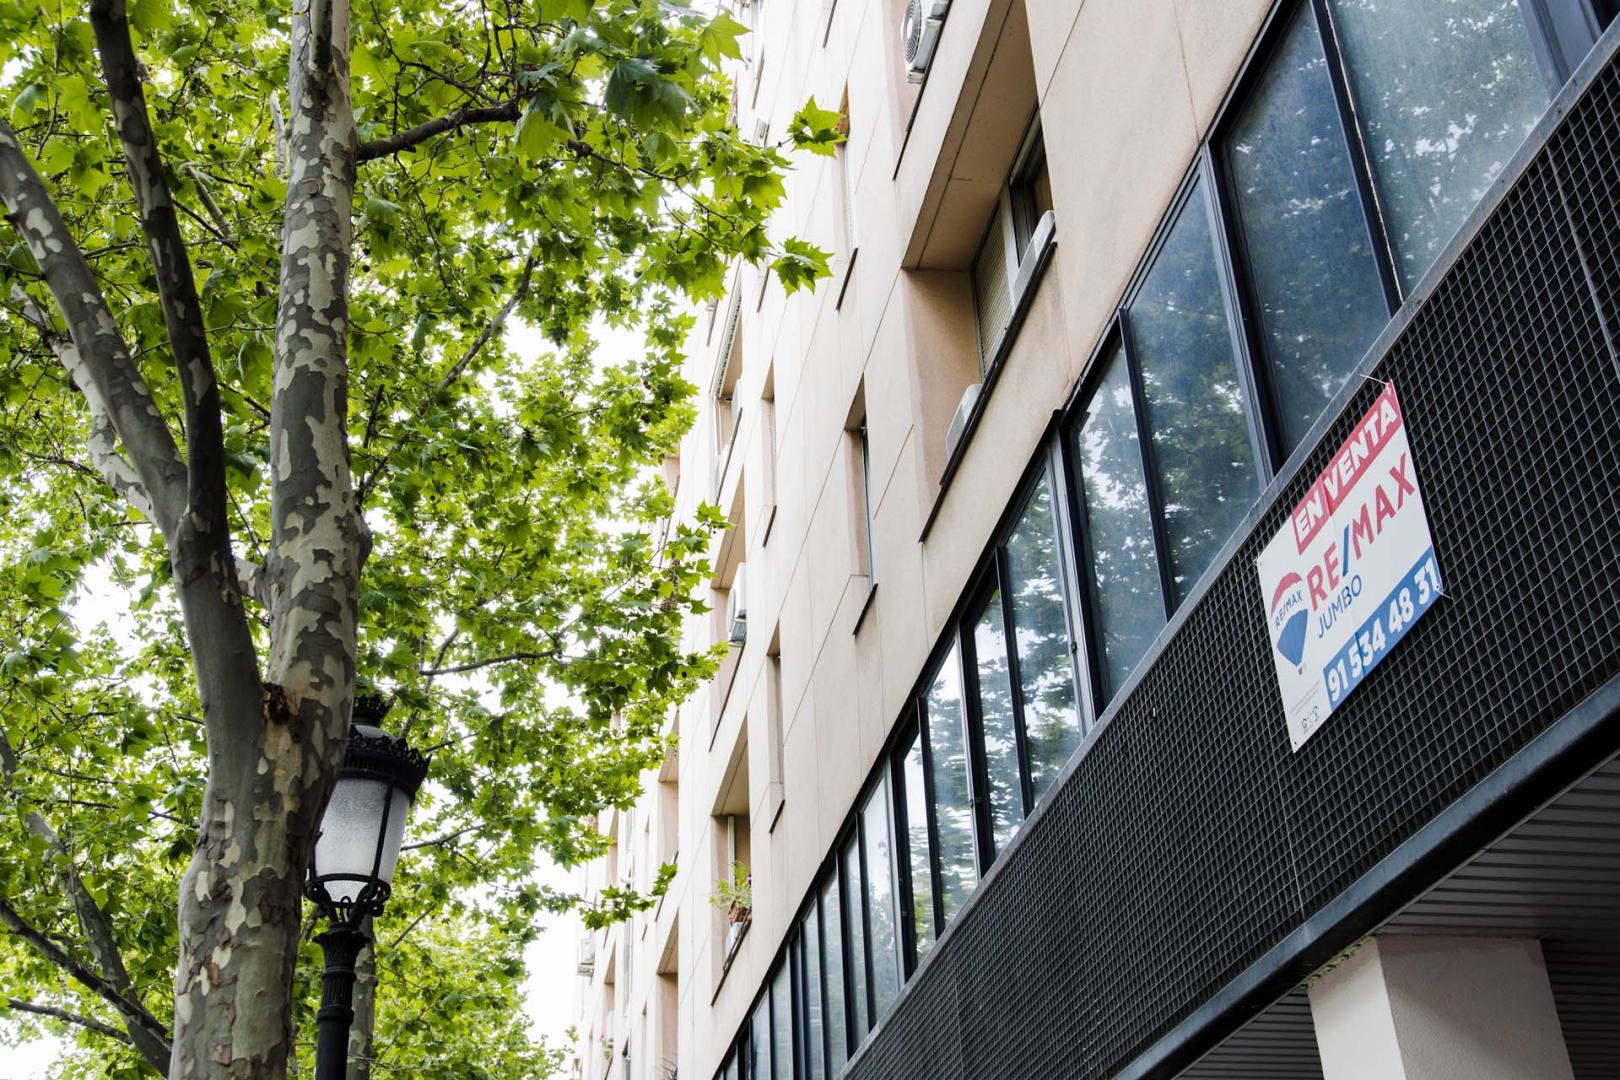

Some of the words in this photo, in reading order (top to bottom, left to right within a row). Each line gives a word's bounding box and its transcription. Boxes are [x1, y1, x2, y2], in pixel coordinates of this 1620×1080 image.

[1294, 488, 1324, 544] EN
[1323, 398, 1398, 500] VENTA
[1307, 452, 1415, 611] RE/MAX
[1274, 590, 1303, 629] RE/MAX
[1318, 575, 1362, 639] JUMBO
[1328, 660, 1349, 701] 91
[1349, 618, 1386, 678] 534
[1388, 588, 1415, 633] 48
[1414, 557, 1439, 604] 31
